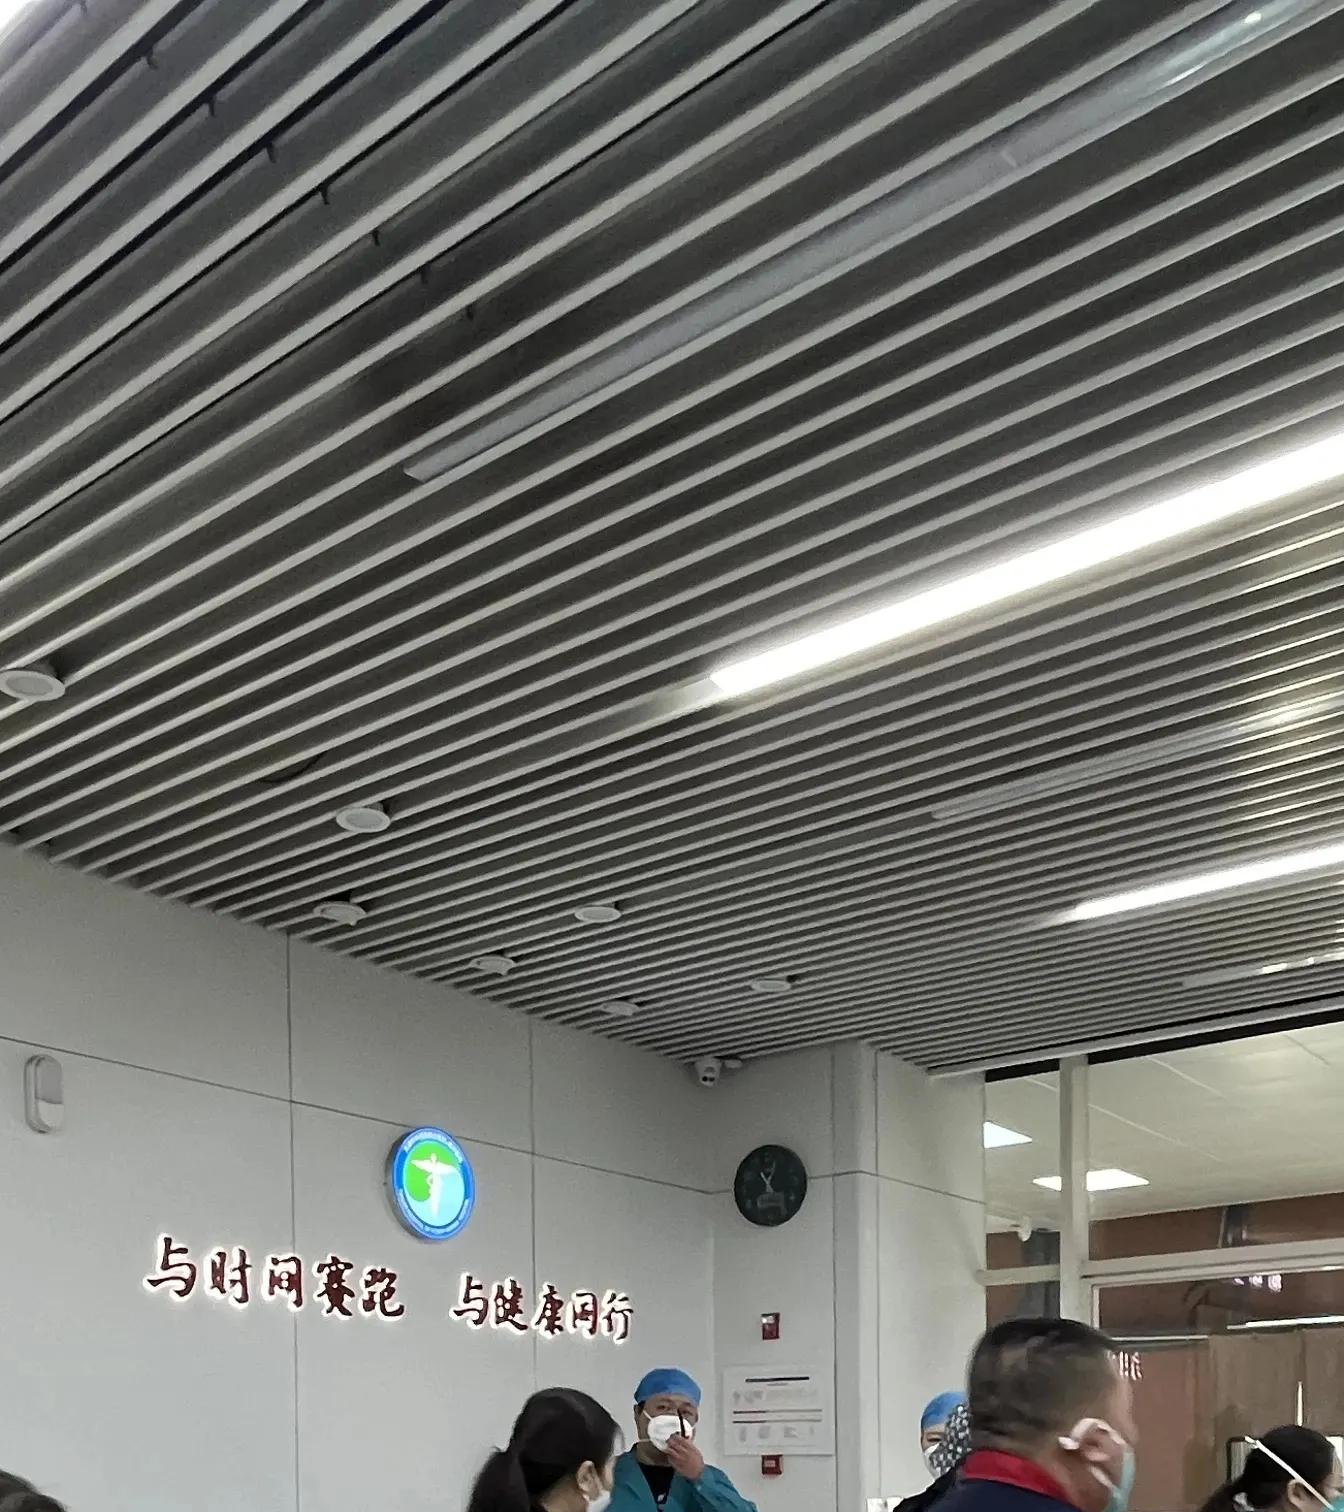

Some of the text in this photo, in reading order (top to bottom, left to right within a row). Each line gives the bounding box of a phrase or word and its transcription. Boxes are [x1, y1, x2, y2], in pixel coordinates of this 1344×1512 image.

[145, 1235, 635, 1343] 与时间赛跑 与健康同行
